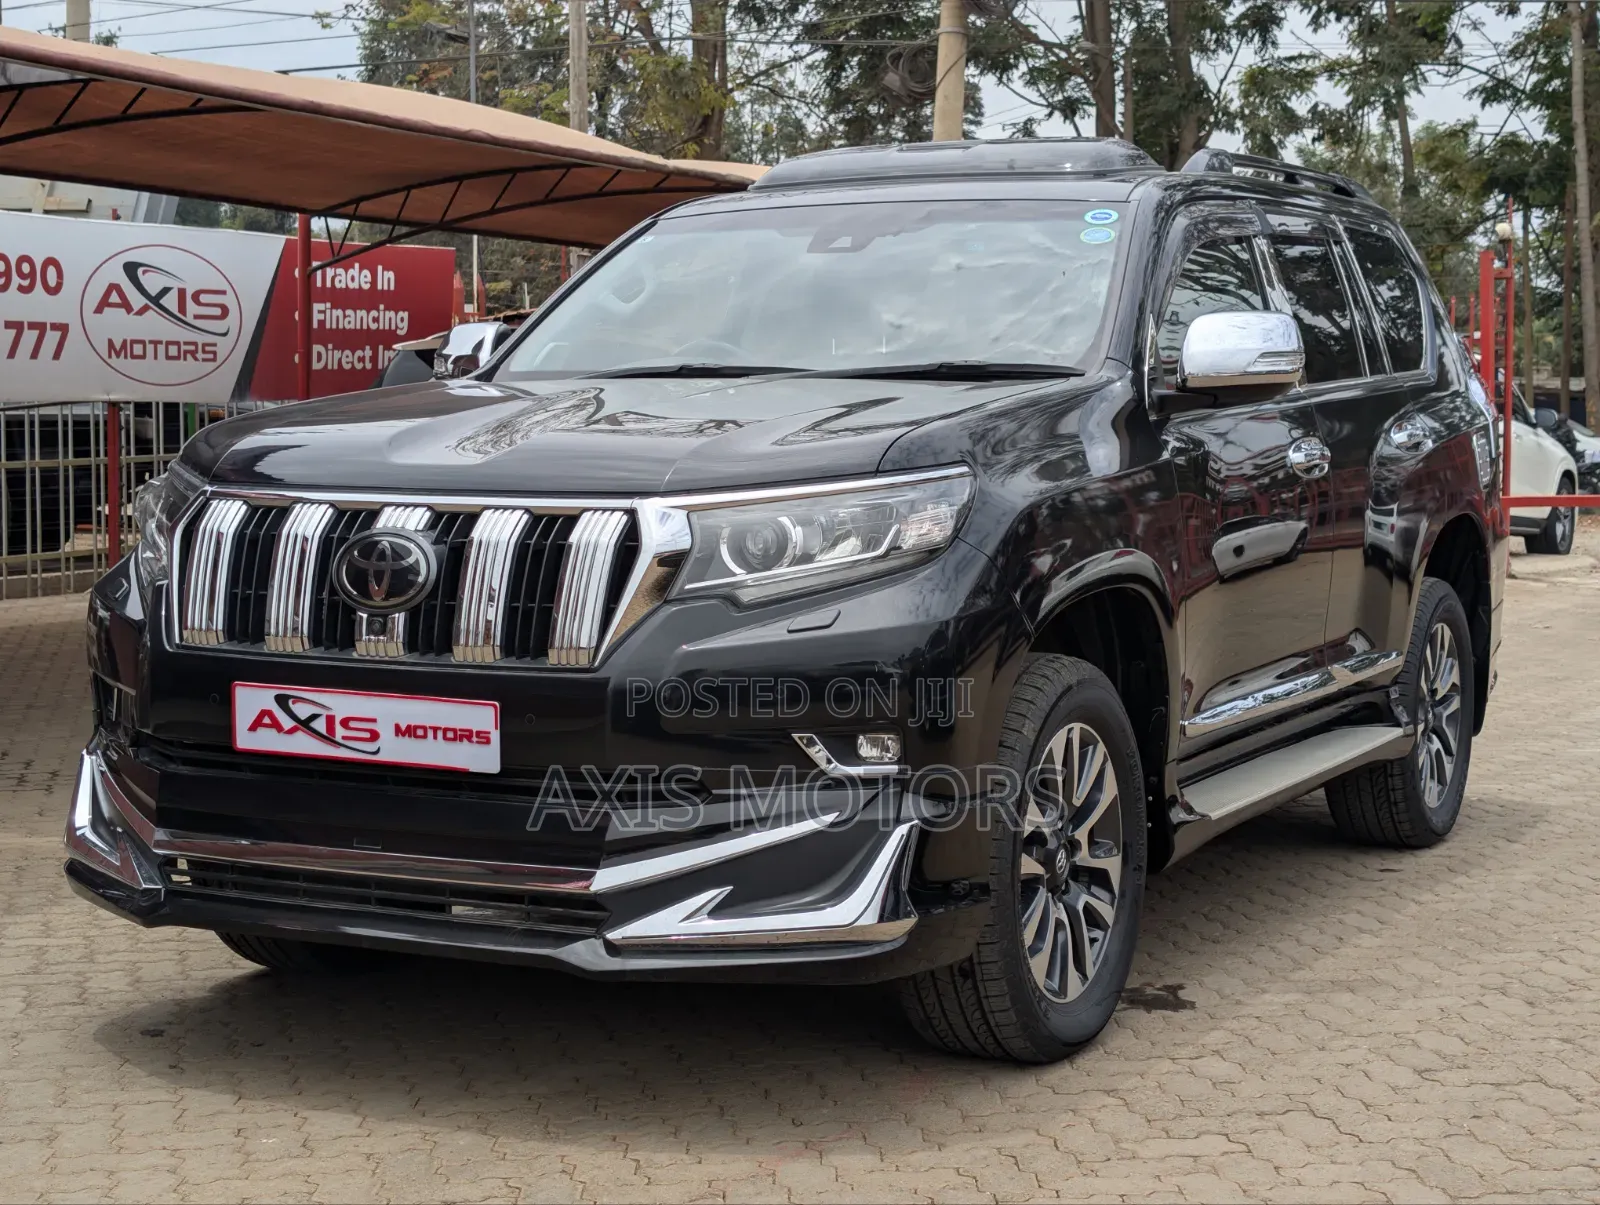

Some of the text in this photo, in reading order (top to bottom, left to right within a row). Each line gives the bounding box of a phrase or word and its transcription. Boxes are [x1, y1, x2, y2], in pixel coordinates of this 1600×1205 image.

[312, 261, 395, 291] Trade In
[93, 261, 230, 337] AXIS
[312, 302, 409, 336] Financing
[4, 320, 70, 361] 777
[107, 337, 218, 363] MOTORS
[312, 344, 373, 370] Direct
[247, 693, 492, 756] AXIS MOTORS
